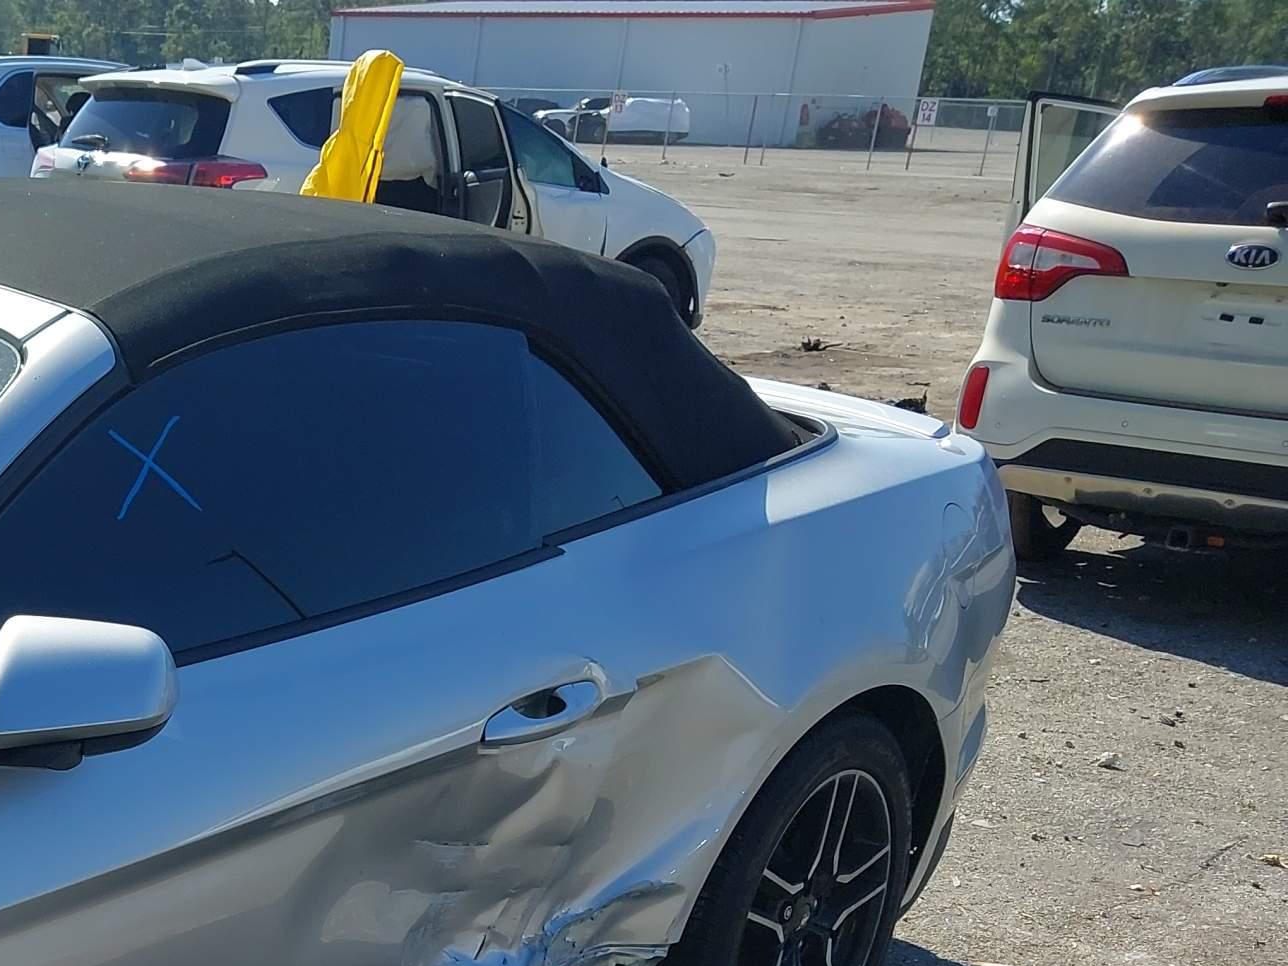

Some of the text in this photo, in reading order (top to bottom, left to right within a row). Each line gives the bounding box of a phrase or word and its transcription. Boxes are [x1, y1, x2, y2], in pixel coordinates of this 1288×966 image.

[920, 101, 937, 112] DZ
[921, 113, 932, 123] 14
[1233, 248, 1271, 265] KIA
